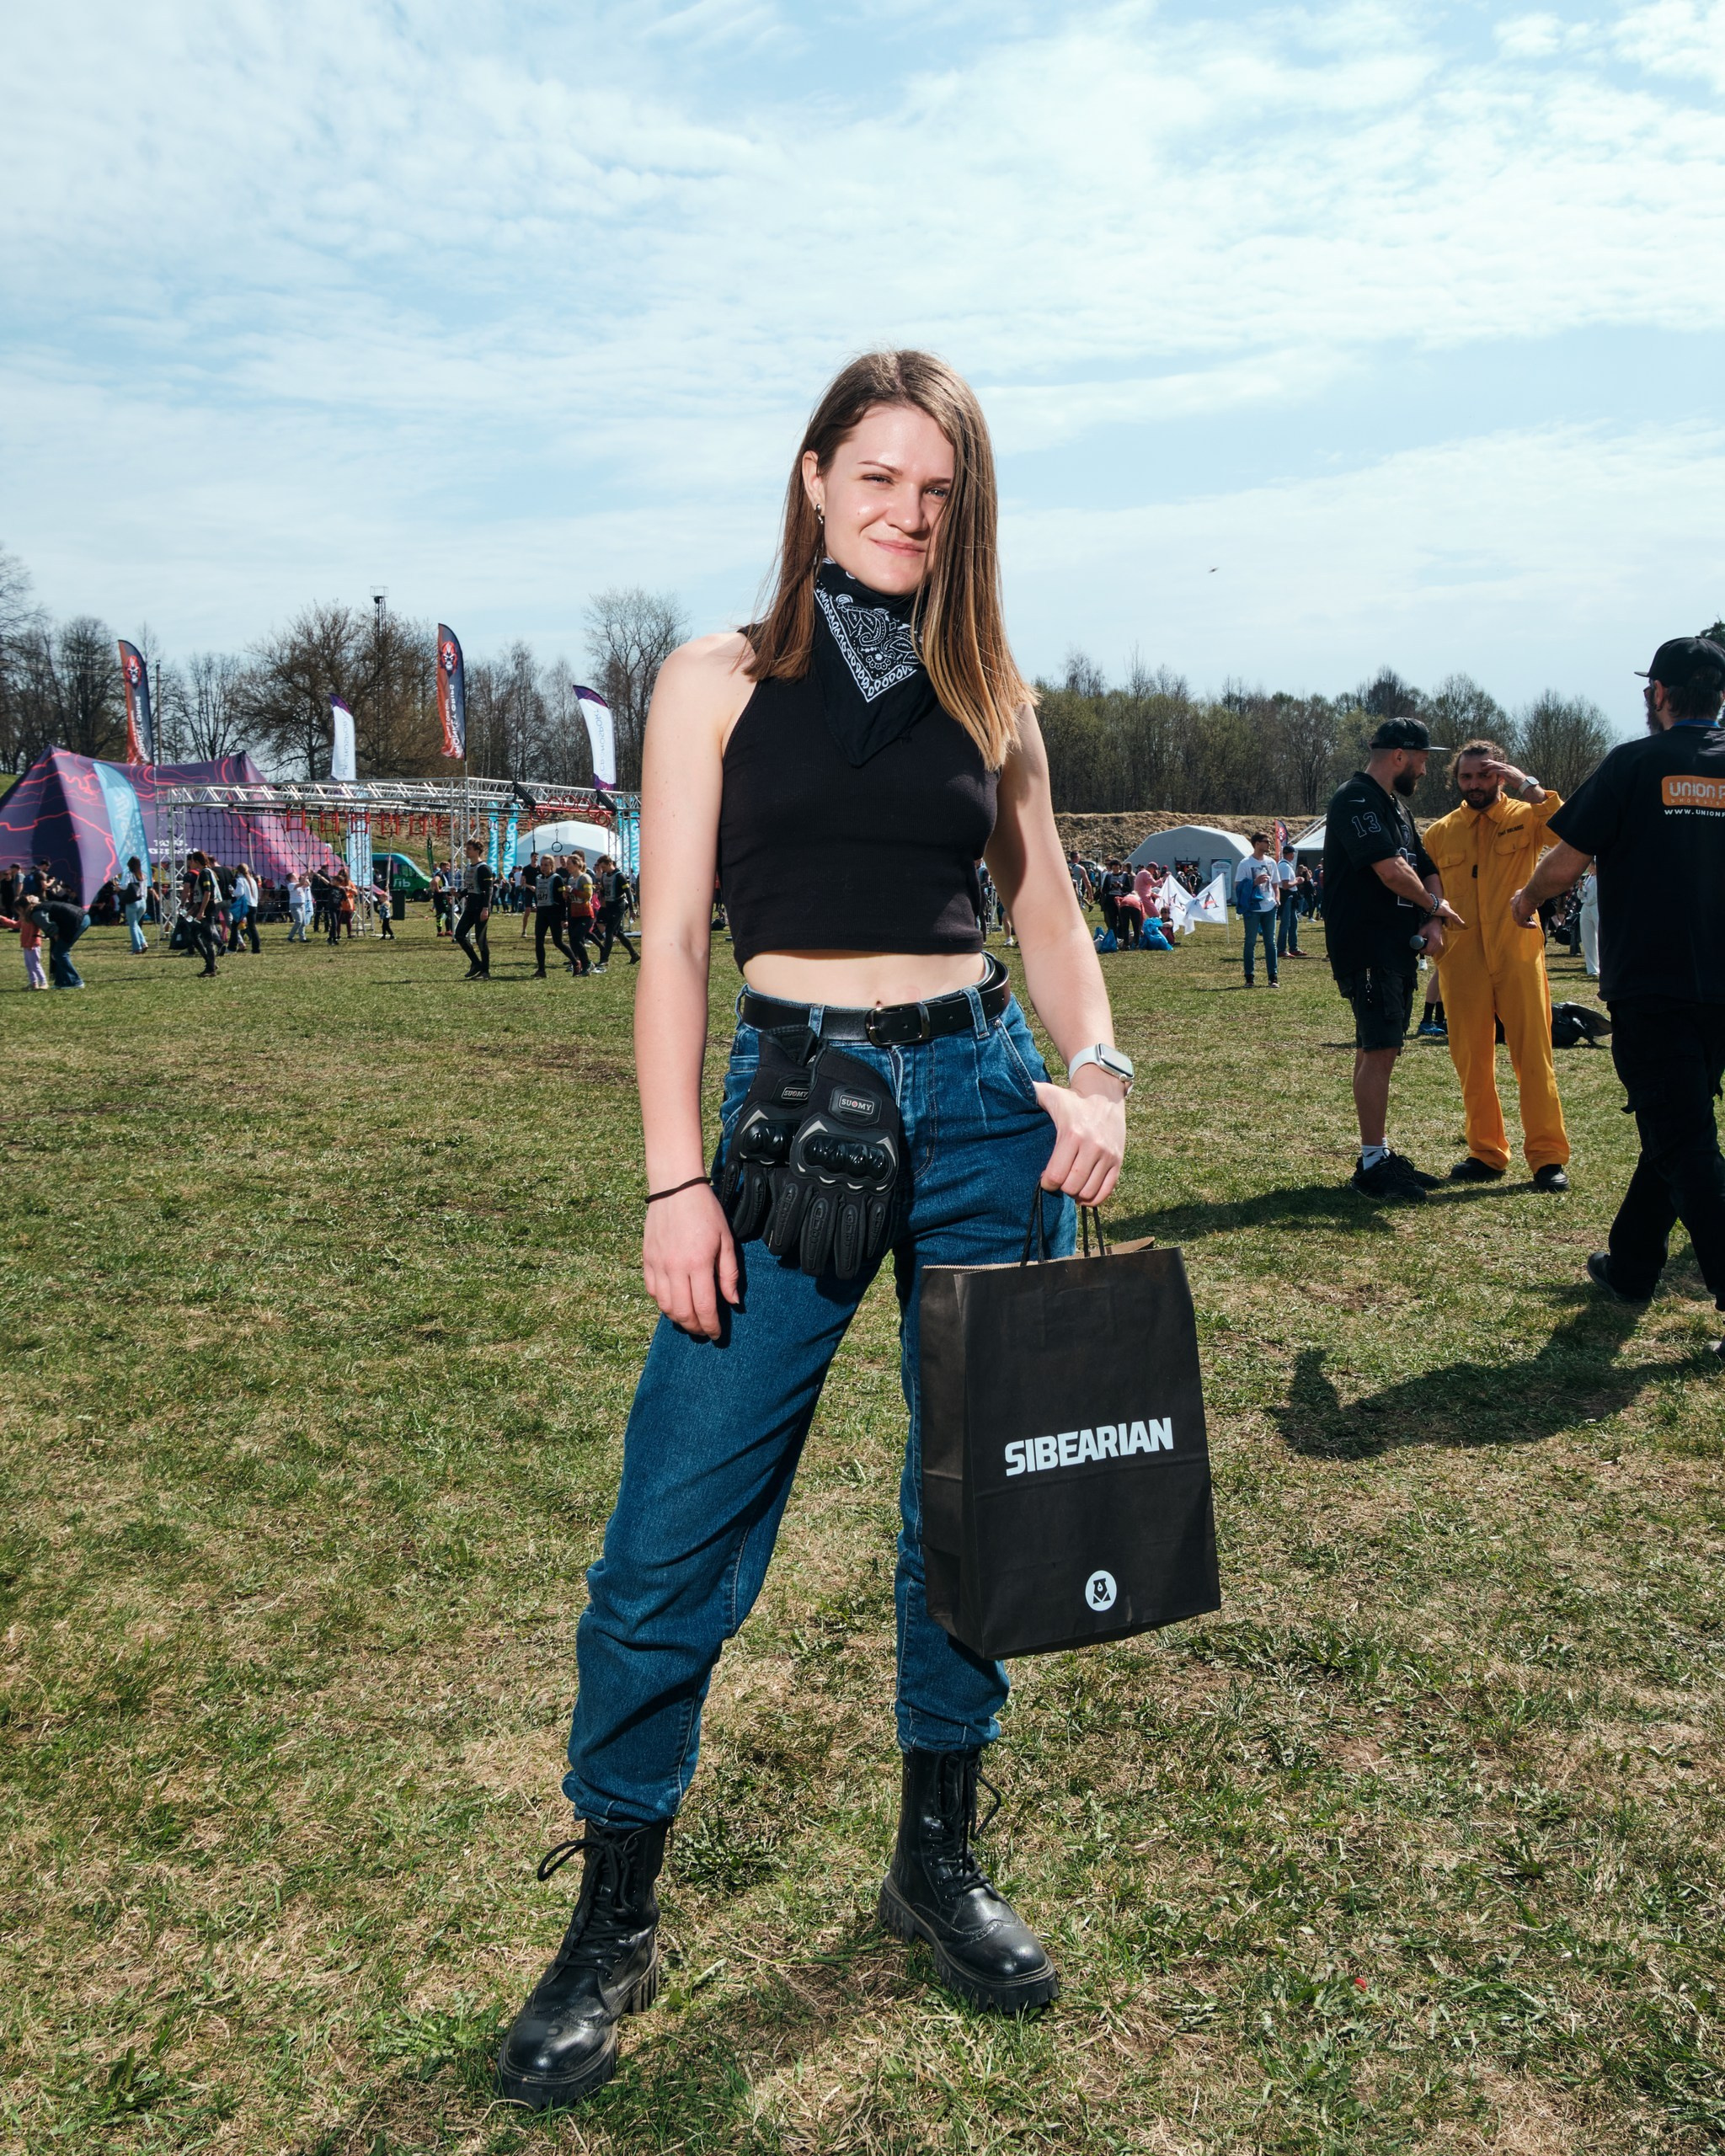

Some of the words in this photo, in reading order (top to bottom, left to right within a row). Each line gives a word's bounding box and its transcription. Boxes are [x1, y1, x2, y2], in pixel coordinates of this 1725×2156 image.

[1351, 811, 1382, 839] 13
[783, 1090, 809, 1098] SUOMY
[841, 1098, 873, 1112] SUOMY
[1005, 1417, 1174, 1476] SIBEARIAN
